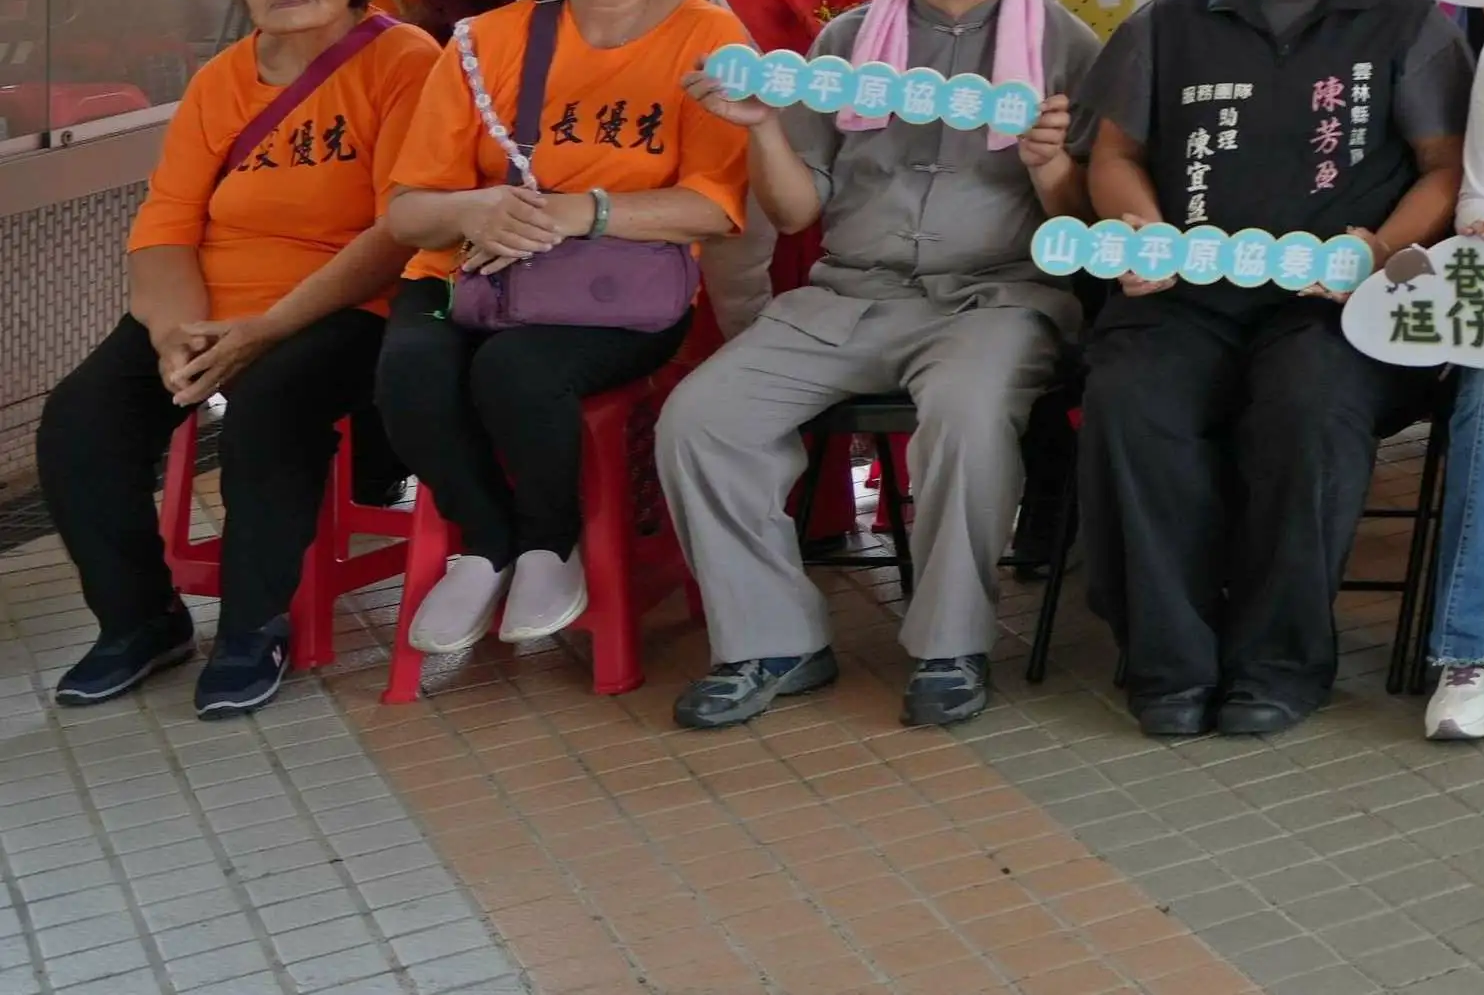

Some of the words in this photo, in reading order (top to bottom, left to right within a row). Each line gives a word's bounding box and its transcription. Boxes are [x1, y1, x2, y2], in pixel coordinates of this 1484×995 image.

[715, 58, 1029, 127] 山海平原協奏曲
[1182, 82, 1254, 105] 服務團隊
[236, 114, 357, 171] 長優先
[1217, 107, 1239, 150] 助理
[1045, 230, 1361, 282] 山海平原協奏曲
